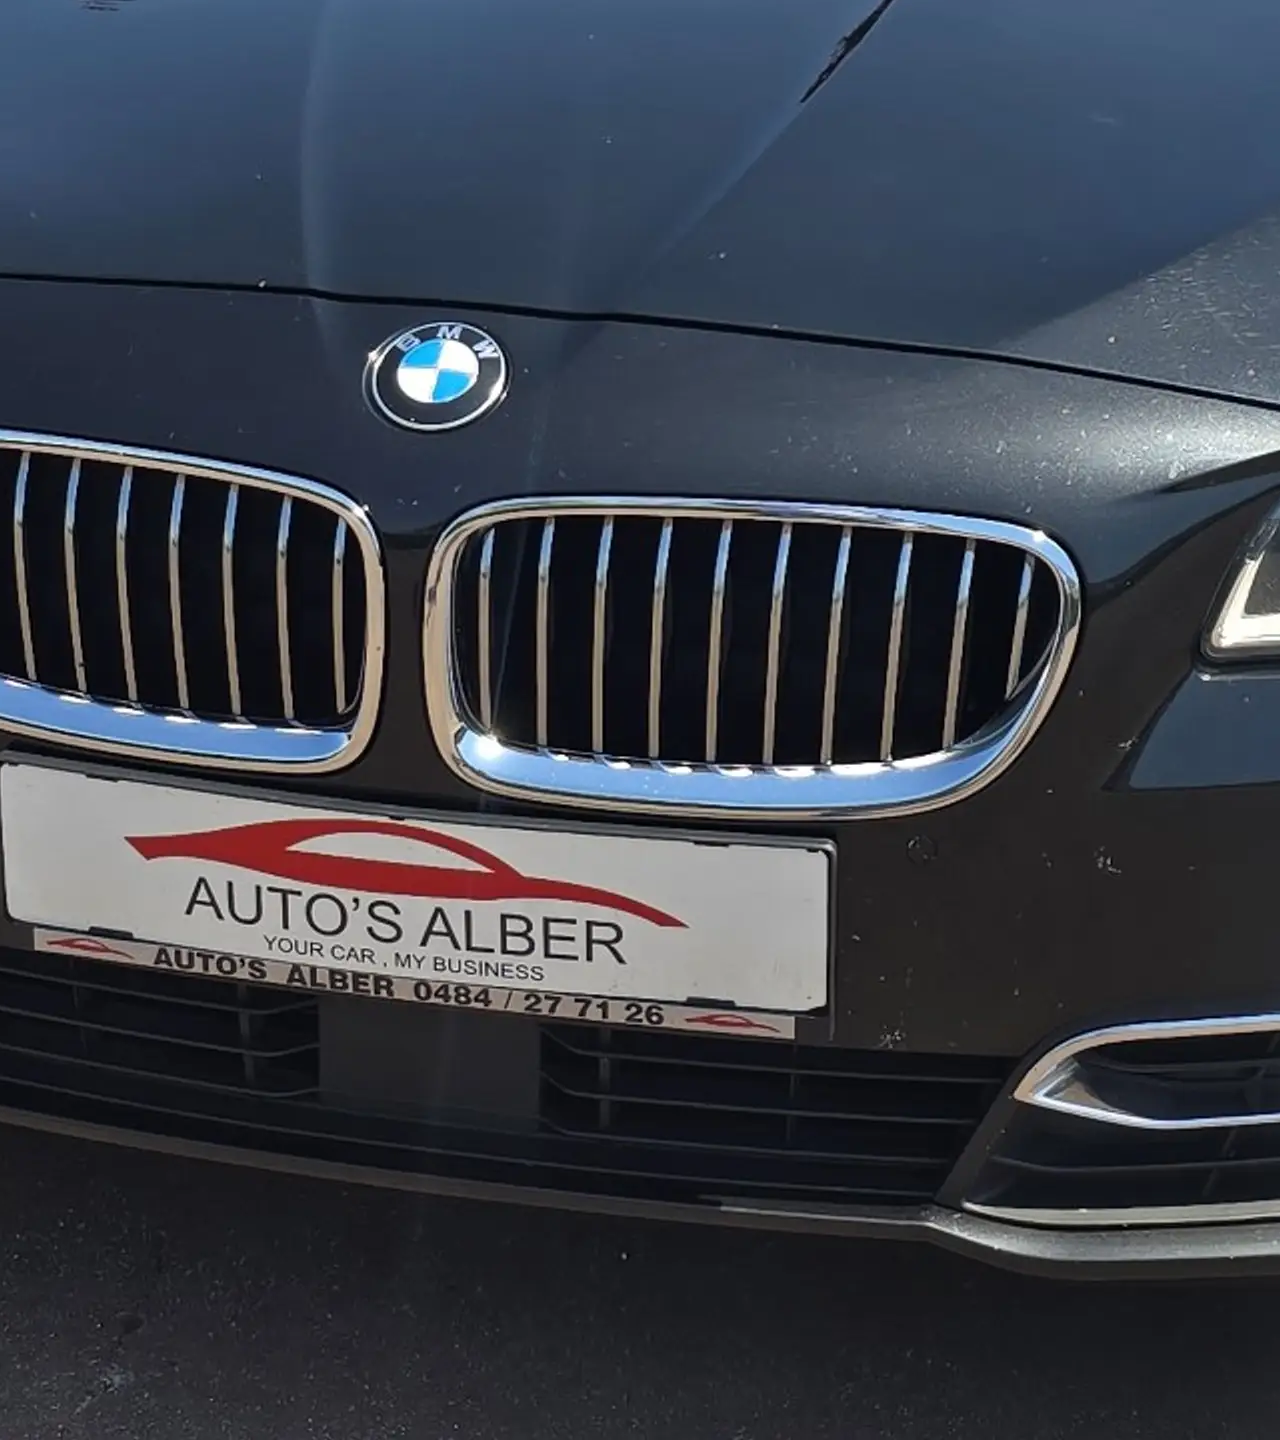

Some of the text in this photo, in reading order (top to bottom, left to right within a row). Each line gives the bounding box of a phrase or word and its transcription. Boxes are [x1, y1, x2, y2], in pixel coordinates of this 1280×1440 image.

[396, 324, 500, 359] BMW
[184, 876, 628, 965] AUTO'S ALBER
[154, 947, 665, 1026] AUTO'S ALBER 0484 / 27 71 26
[263, 934, 324, 958] YOUR
[330, 944, 376, 965] CAR
[394, 951, 426, 970] MY
[433, 955, 545, 982] BUSINESS
